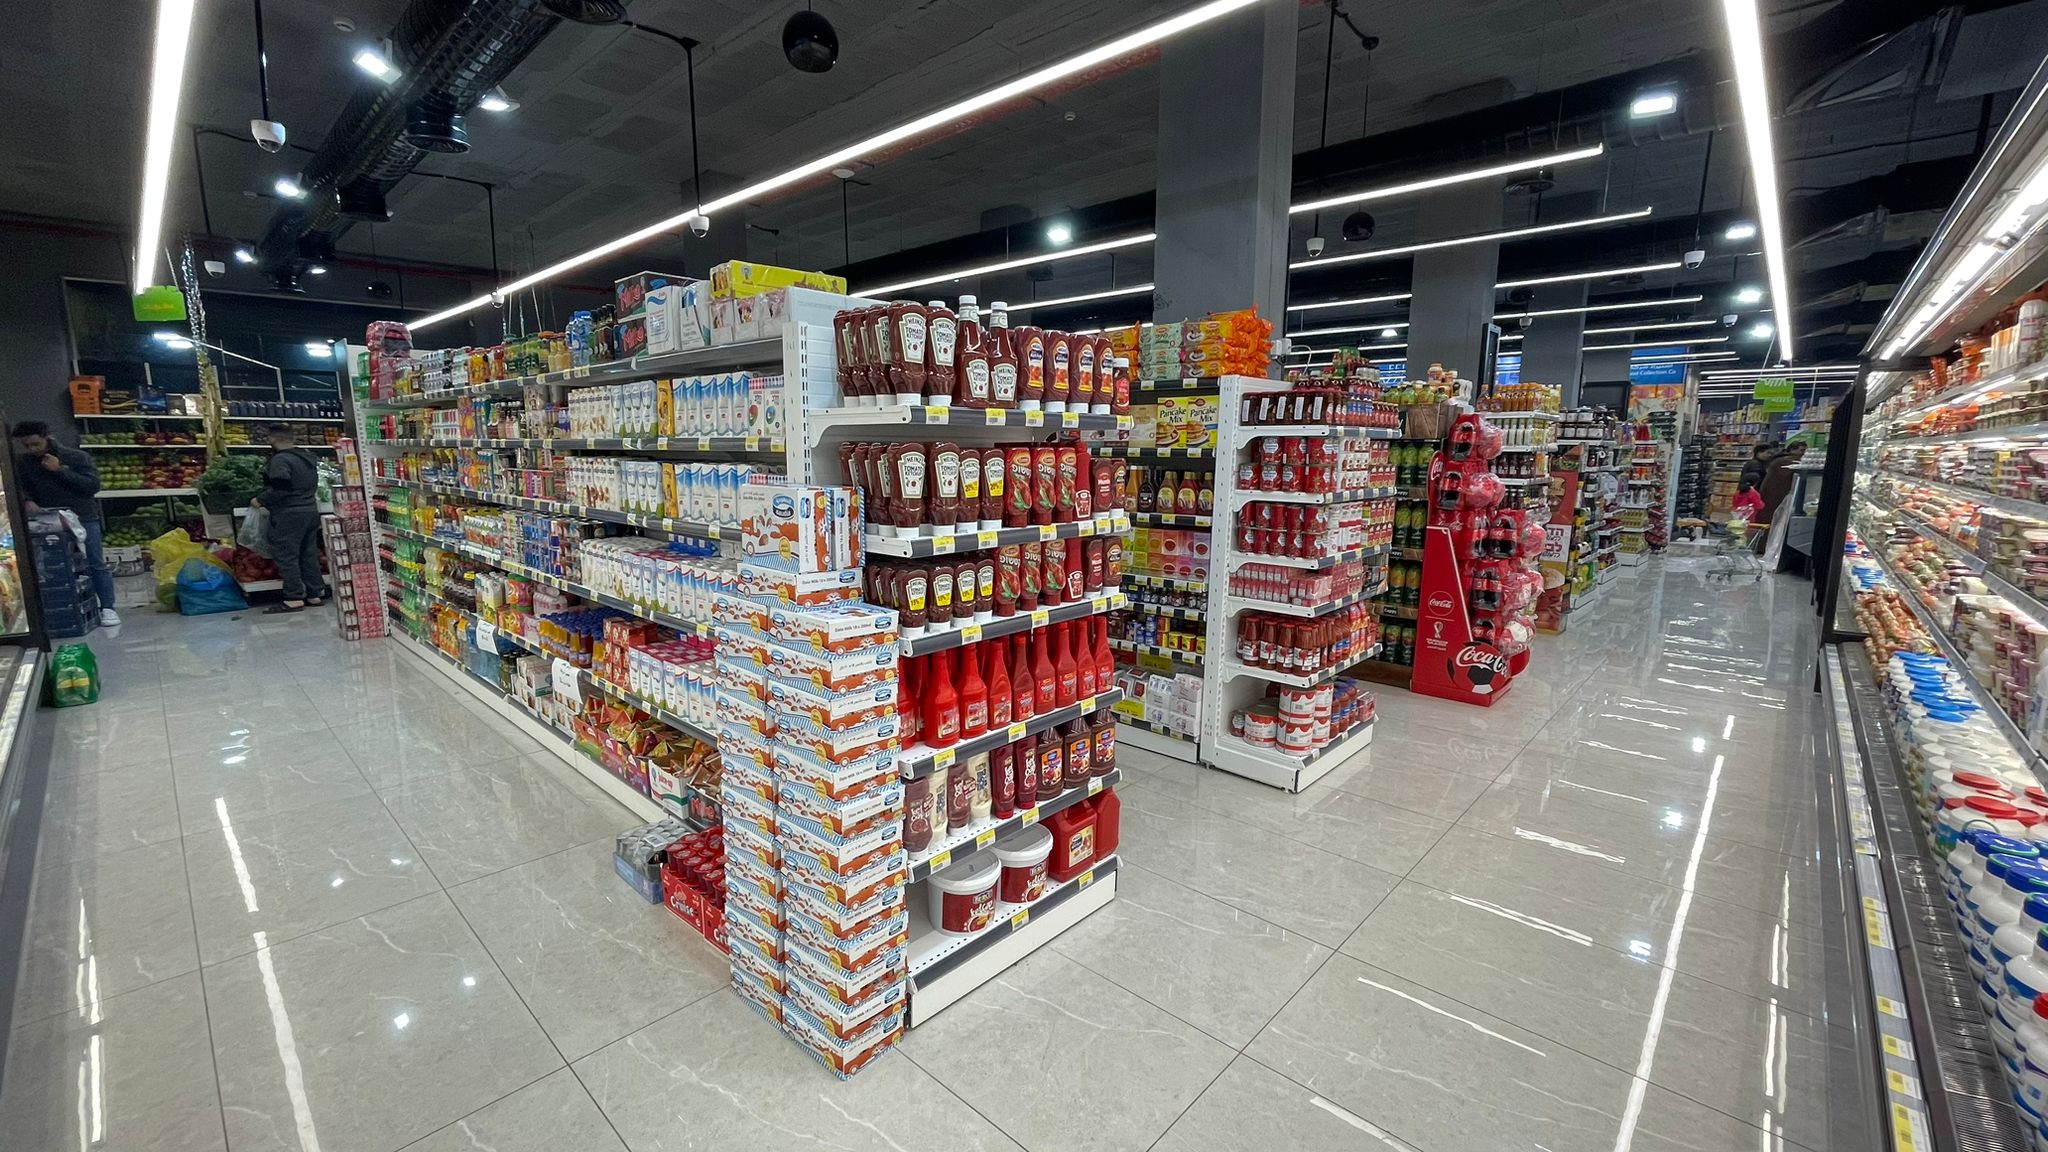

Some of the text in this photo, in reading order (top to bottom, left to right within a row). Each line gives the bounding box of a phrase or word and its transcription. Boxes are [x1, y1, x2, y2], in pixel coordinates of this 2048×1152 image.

[908, 318, 922, 326] HEINZ
[1160, 407, 1187, 418] Pancake
[1190, 406, 1217, 417] Pancake
[1169, 415, 1183, 423] Mix
[1200, 414, 1213, 422] Mix
[1429, 598, 1453, 609] Coca-Cola
